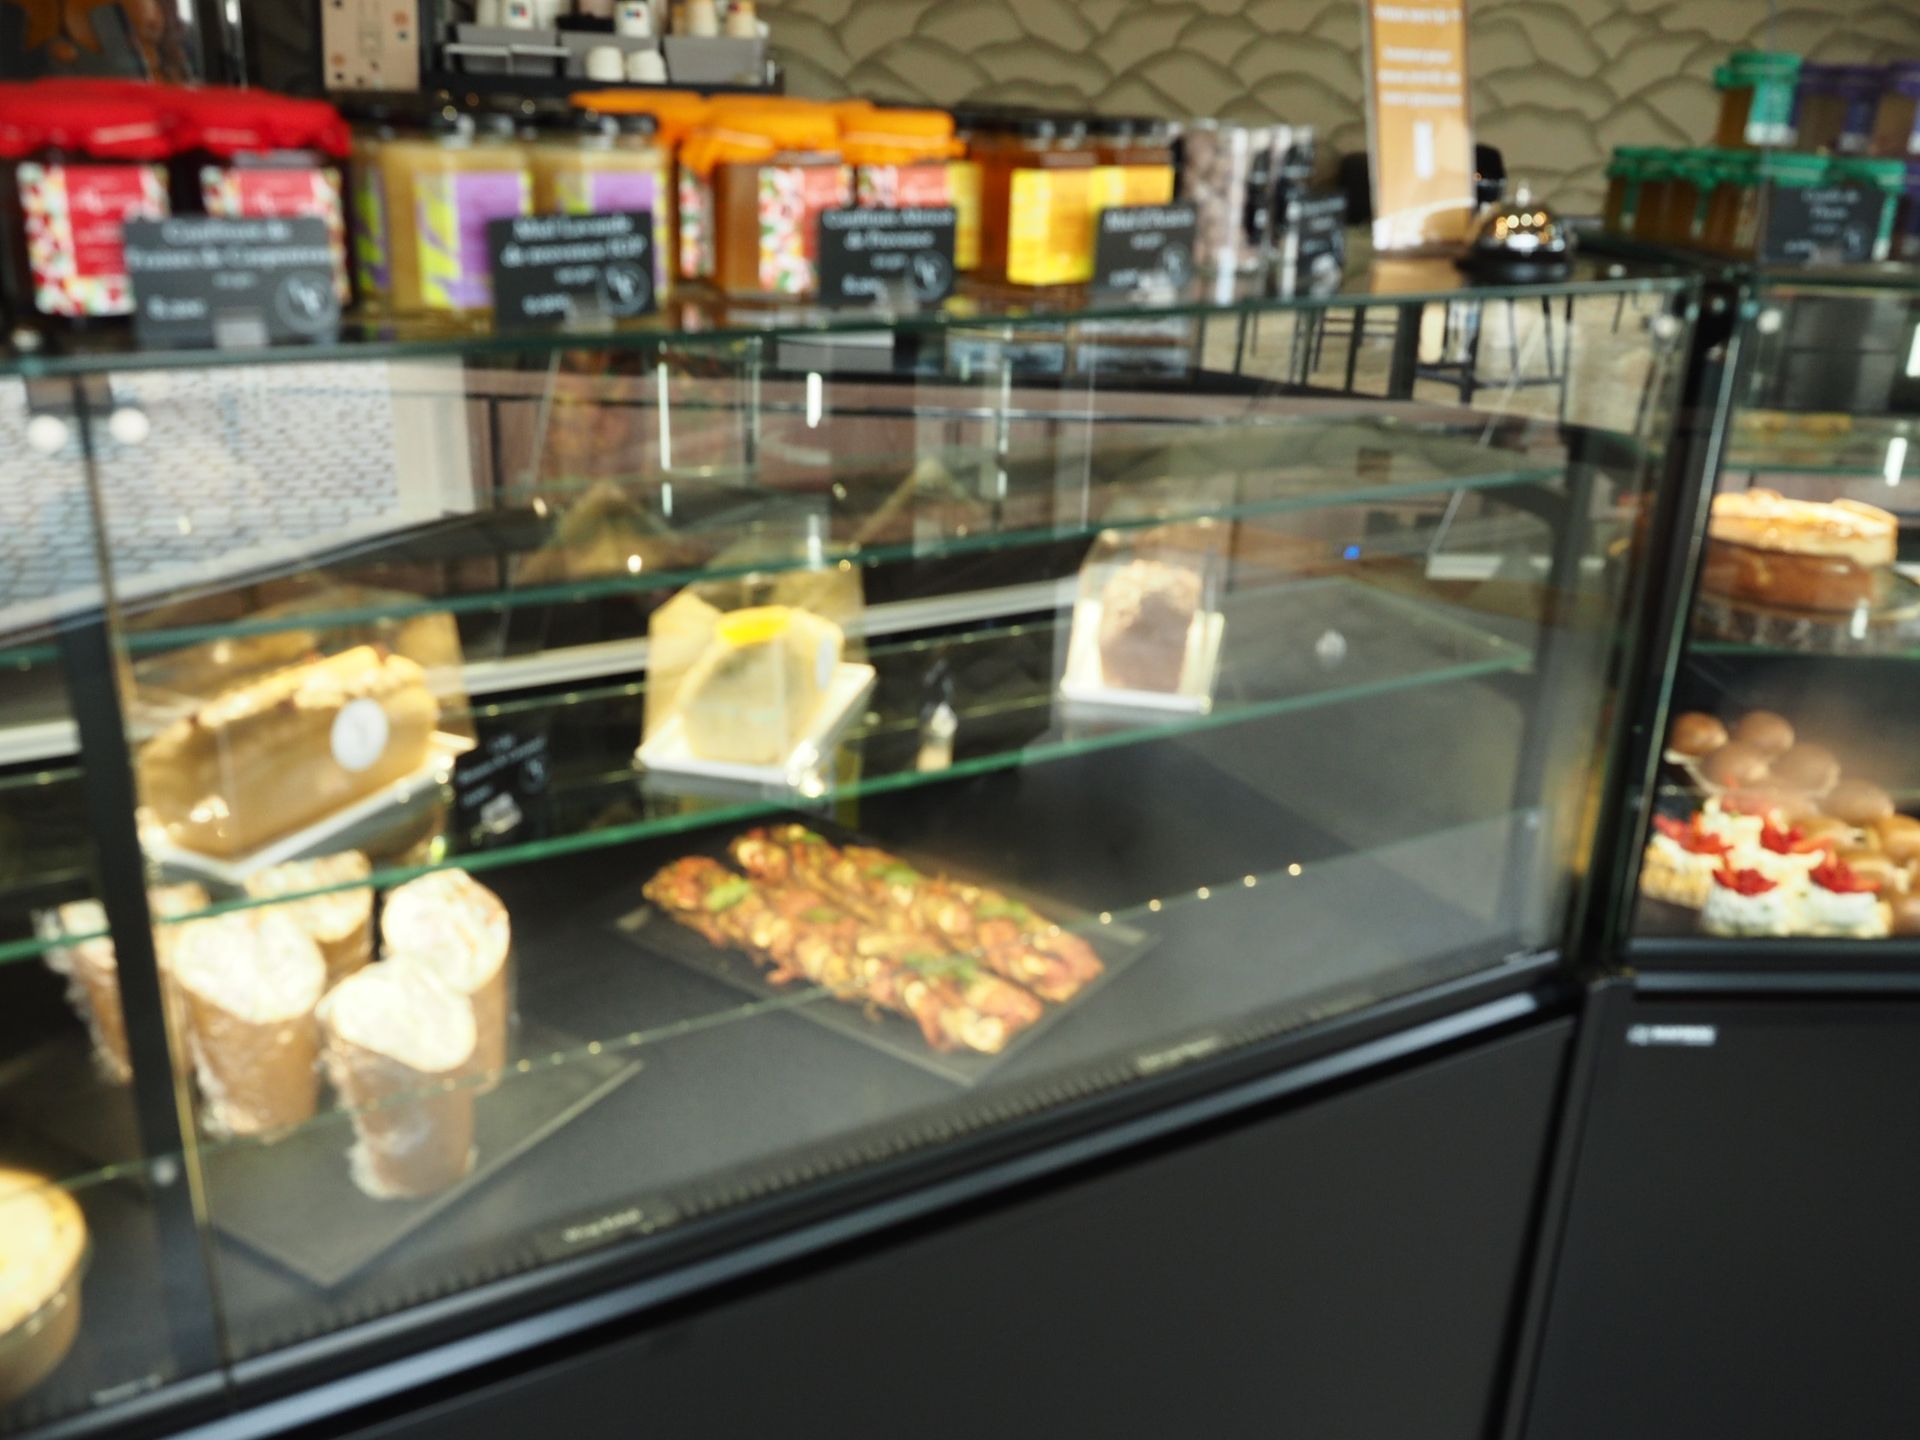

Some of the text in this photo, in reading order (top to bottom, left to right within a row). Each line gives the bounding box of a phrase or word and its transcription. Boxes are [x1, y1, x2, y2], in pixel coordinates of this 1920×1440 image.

[514, 214, 633, 239] Miel Lavande
[824, 209, 898, 228] Confiture
[163, 219, 291, 243] Confiture de
[845, 230, 866, 249] de
[199, 246, 222, 268] de
[502, 243, 525, 266] de
